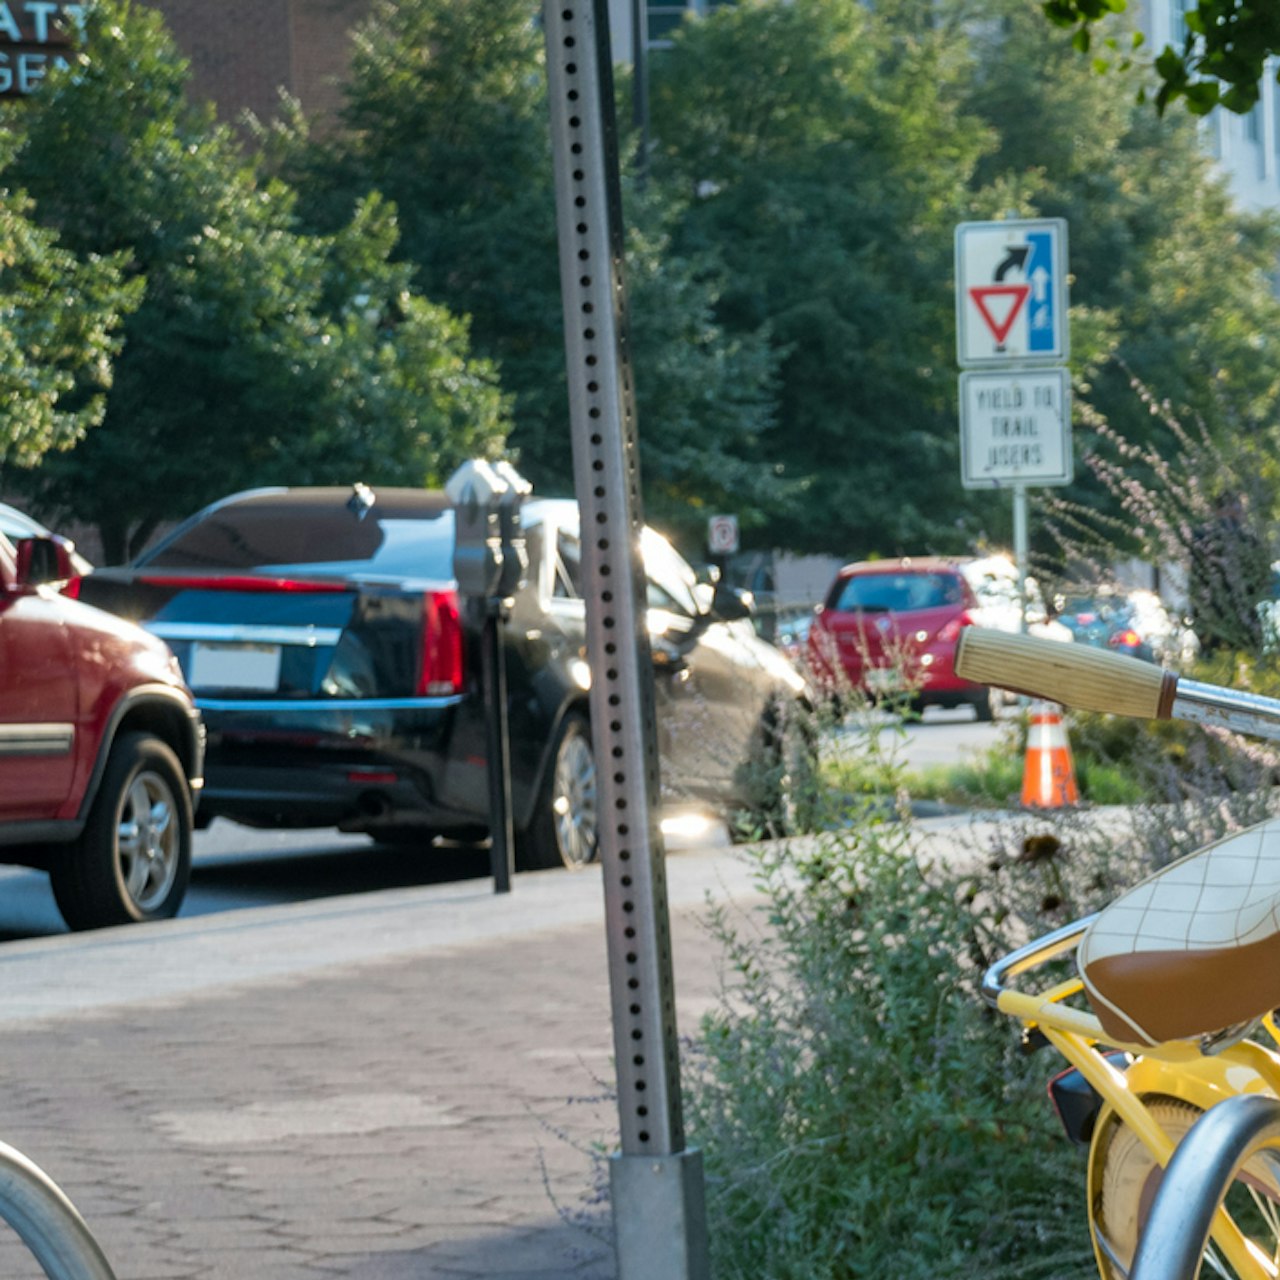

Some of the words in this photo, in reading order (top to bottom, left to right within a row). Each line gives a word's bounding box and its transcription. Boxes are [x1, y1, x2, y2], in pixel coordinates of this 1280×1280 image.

[976, 386, 1023, 410] YIELD
[1034, 385, 1053, 409] TO
[991, 415, 1038, 437] TRAIL
[988, 444, 1042, 466] USERS
